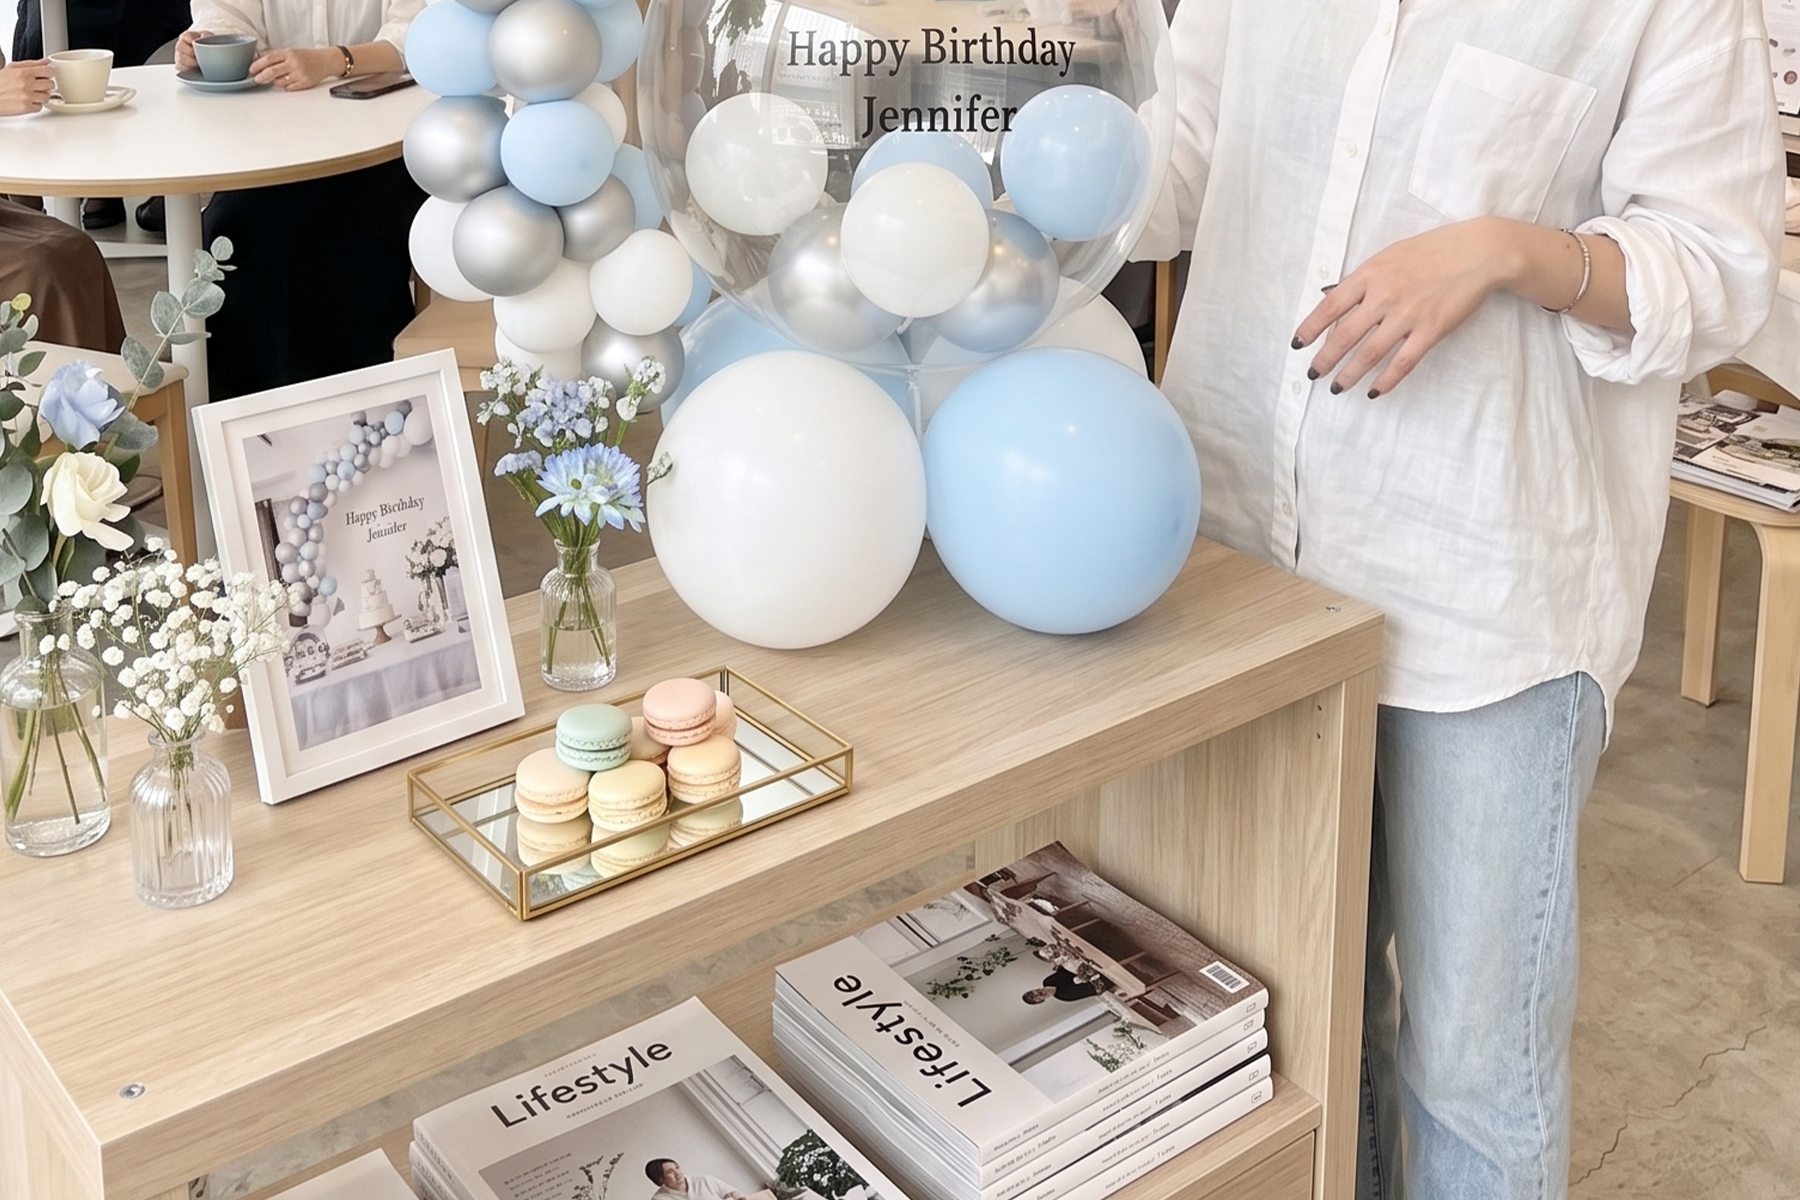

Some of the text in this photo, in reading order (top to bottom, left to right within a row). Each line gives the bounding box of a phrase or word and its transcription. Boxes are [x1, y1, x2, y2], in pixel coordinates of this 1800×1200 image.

[787, 26, 1077, 78] Happy Birthday
[862, 93, 1018, 139] Jennifer
[345, 509, 378, 527] Happy
[833, 974, 992, 1108] Lifestyle
[490, 1043, 673, 1128] Lifestyle
